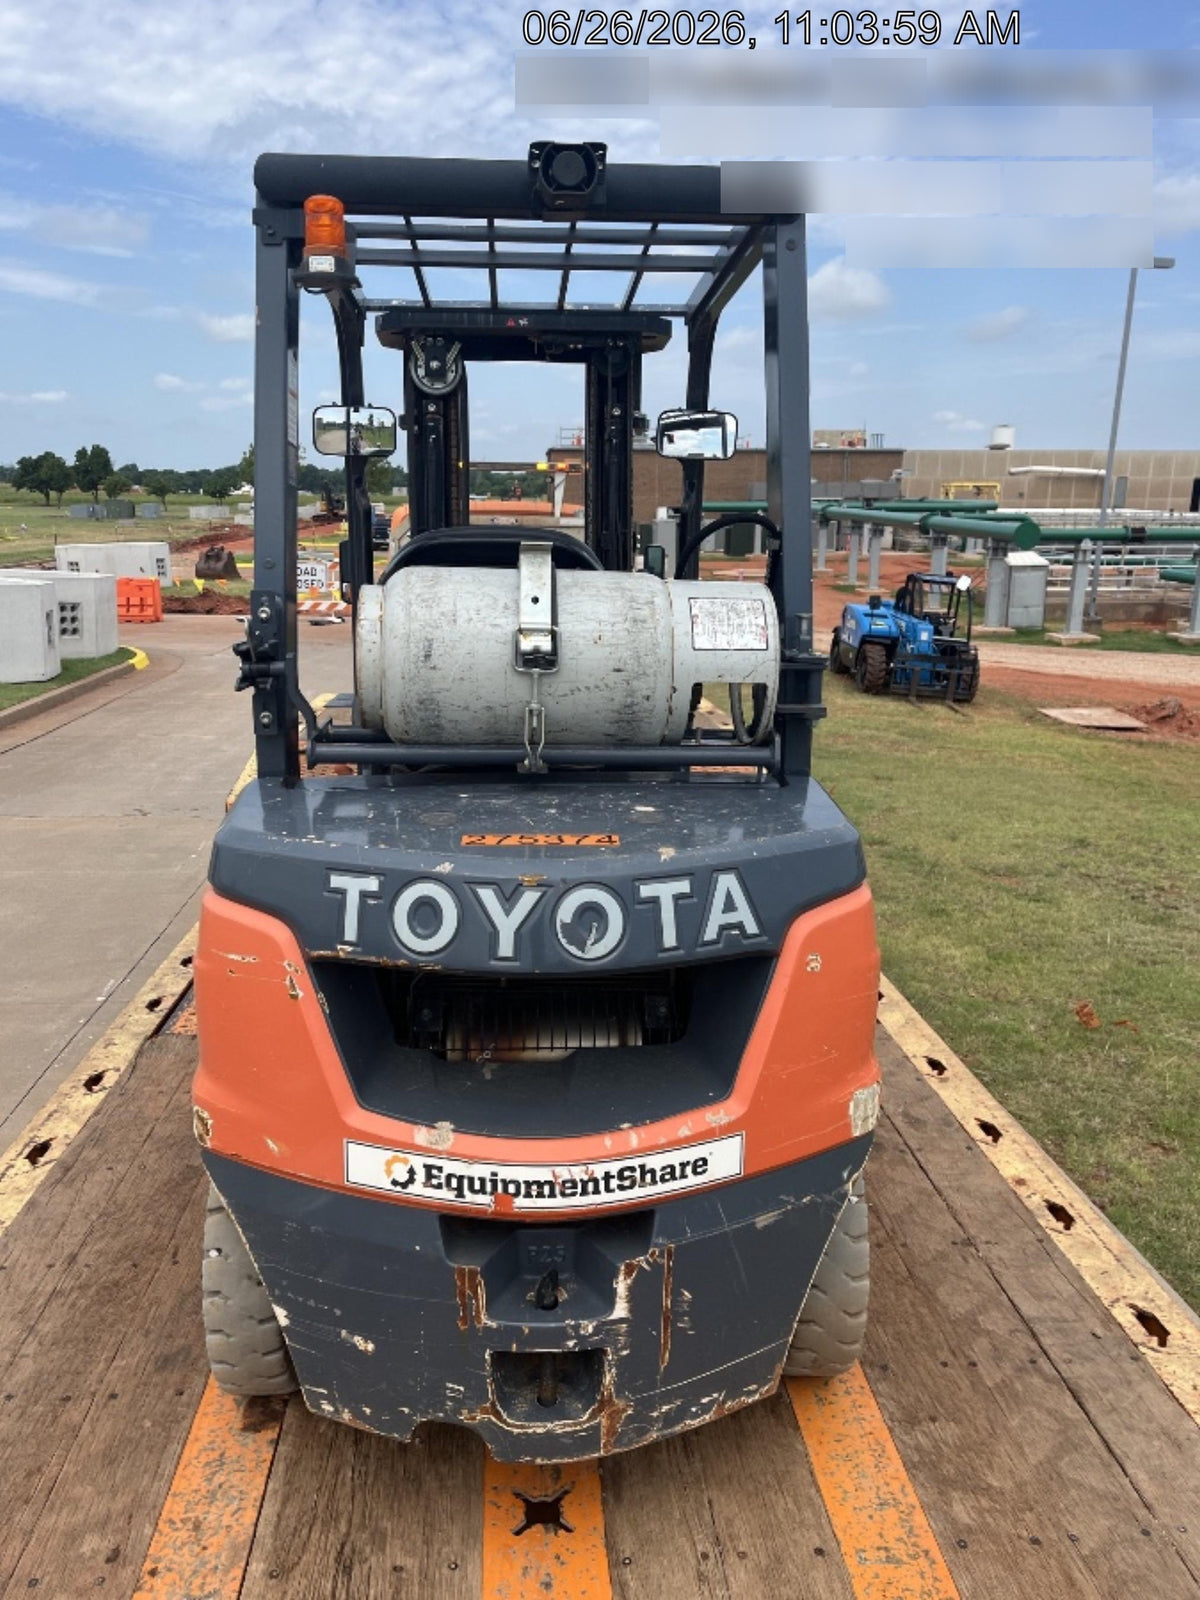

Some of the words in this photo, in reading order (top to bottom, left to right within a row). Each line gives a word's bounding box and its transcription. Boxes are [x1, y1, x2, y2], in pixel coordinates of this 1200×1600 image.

[296, 566, 317, 576] OAD
[296, 579, 324, 589] OSED
[465, 834, 617, 846] 275374
[329, 873, 761, 960] TOYOTA
[422, 1156, 709, 1200] EquipmentShare
